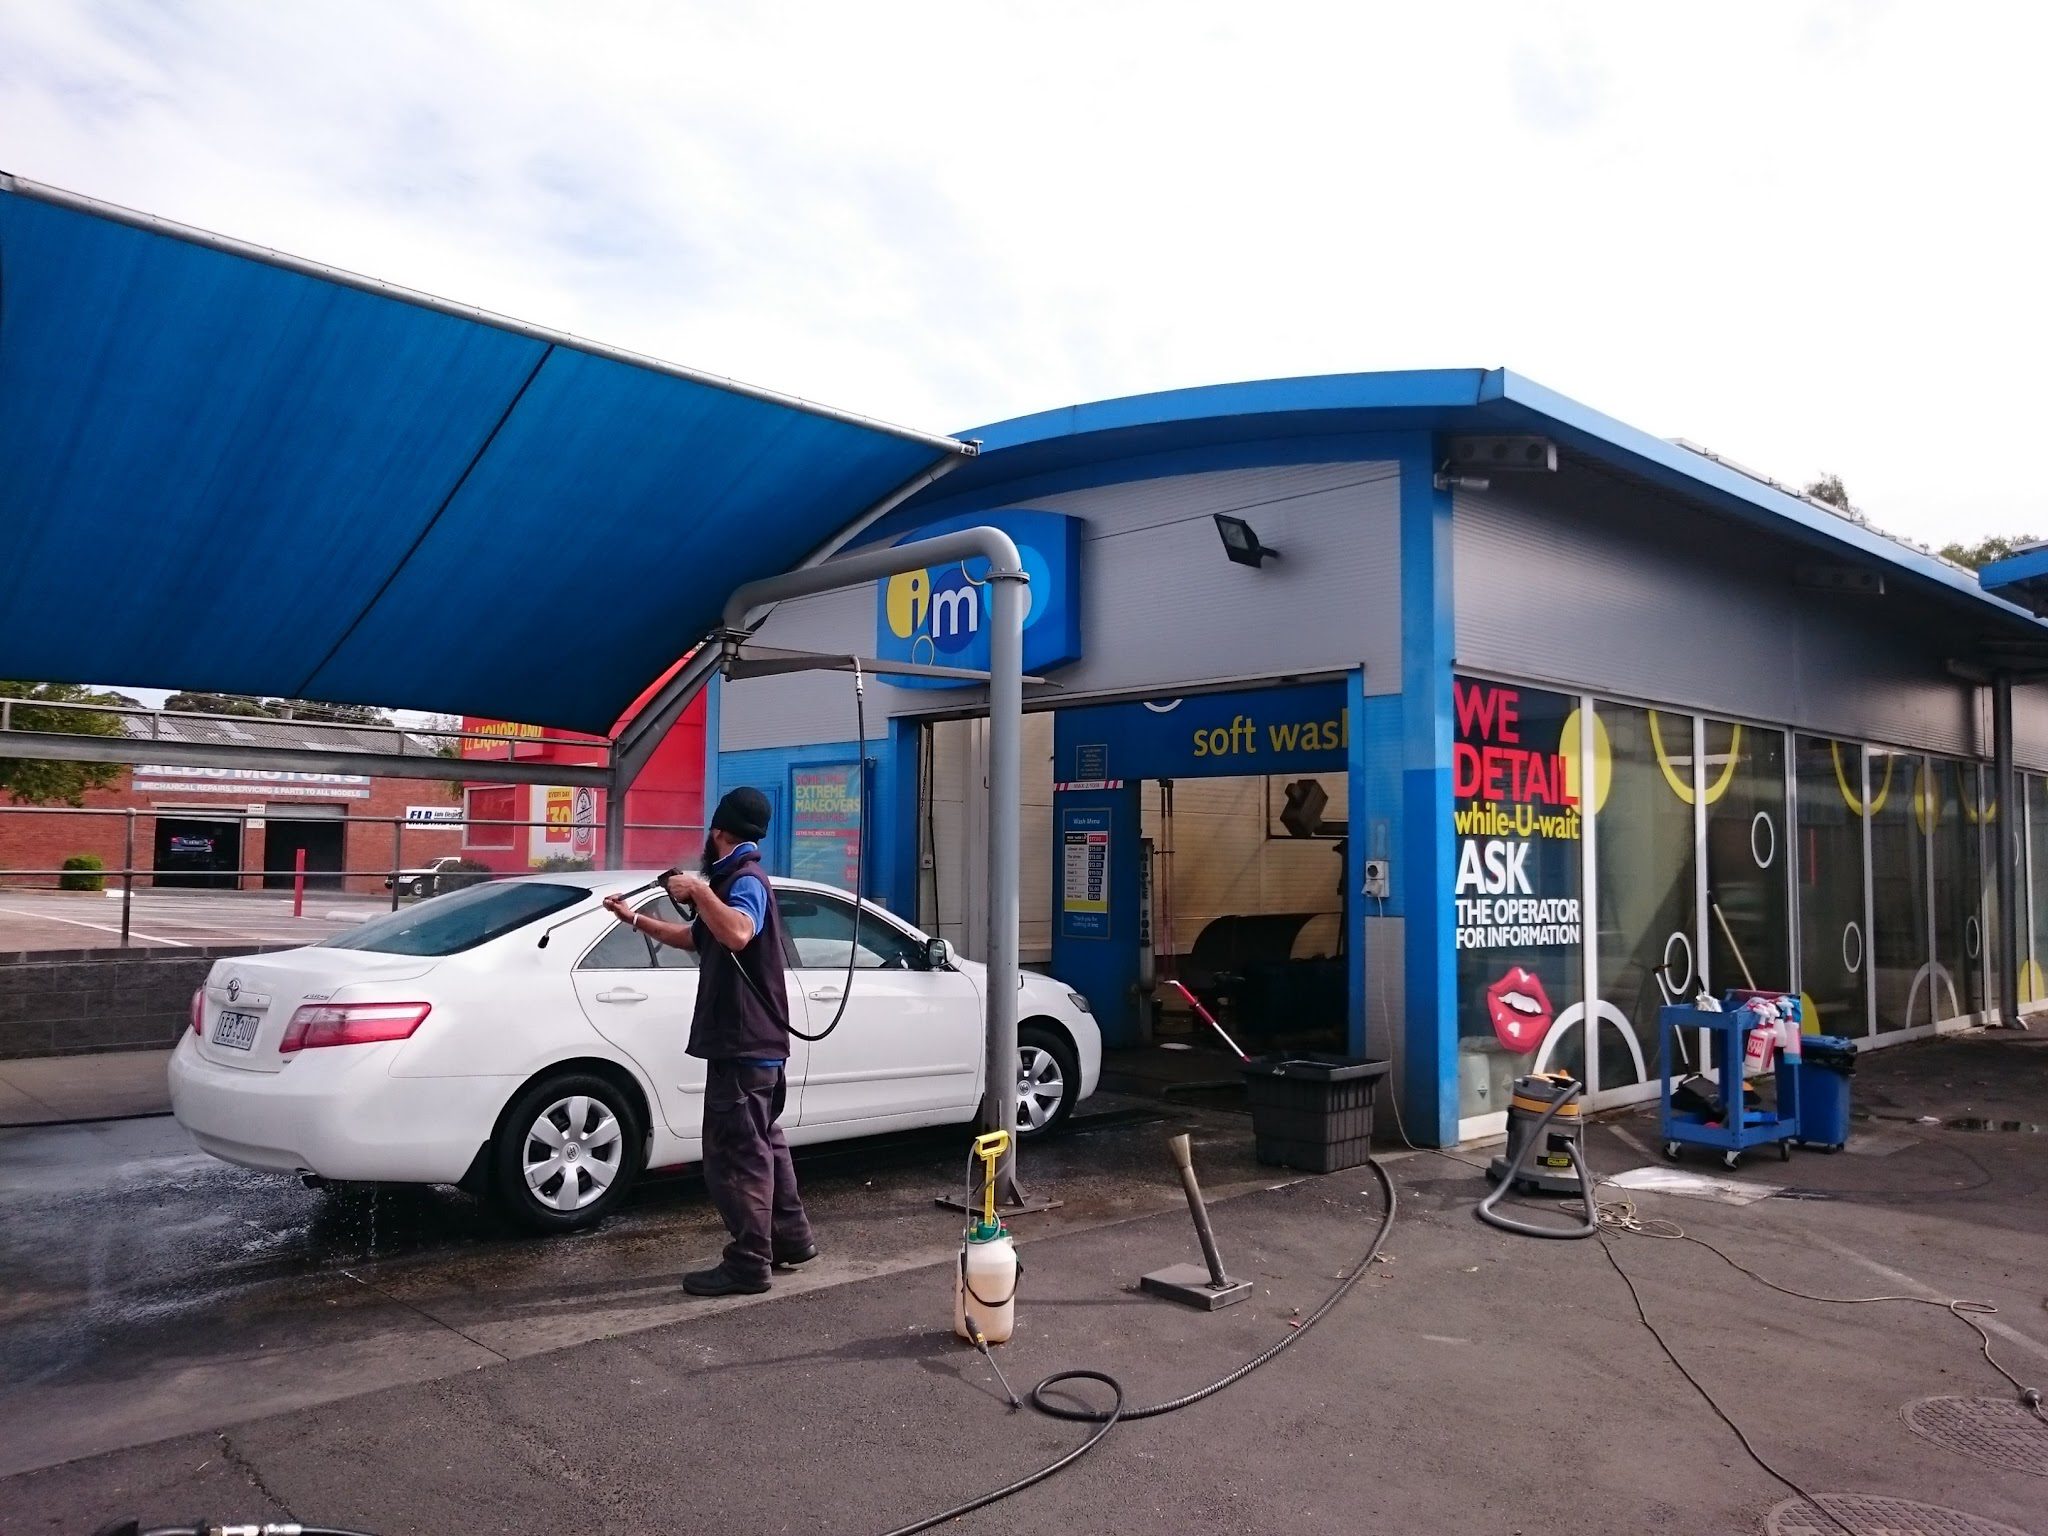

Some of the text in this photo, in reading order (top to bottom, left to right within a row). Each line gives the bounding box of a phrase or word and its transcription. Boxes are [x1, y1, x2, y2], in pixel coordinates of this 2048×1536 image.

[1453, 681, 1520, 744] WE
[1193, 715, 1257, 757] soft
[140, 782, 195, 791] MECHANICAL
[232, 785, 273, 794] SERVICING
[280, 787, 304, 795] PARTS
[331, 789, 361, 797] MODELS
[1453, 742, 1579, 806] DETAIL
[796, 784, 846, 799] EXTREME
[796, 799, 860, 812] MAKEOVERS
[1454, 801, 1580, 839] while-U-wait
[1454, 839, 1531, 895] ASK
[1455, 898, 1580, 925] THE OPERATOR
[1456, 923, 1580, 949] FOR INFORMATION
